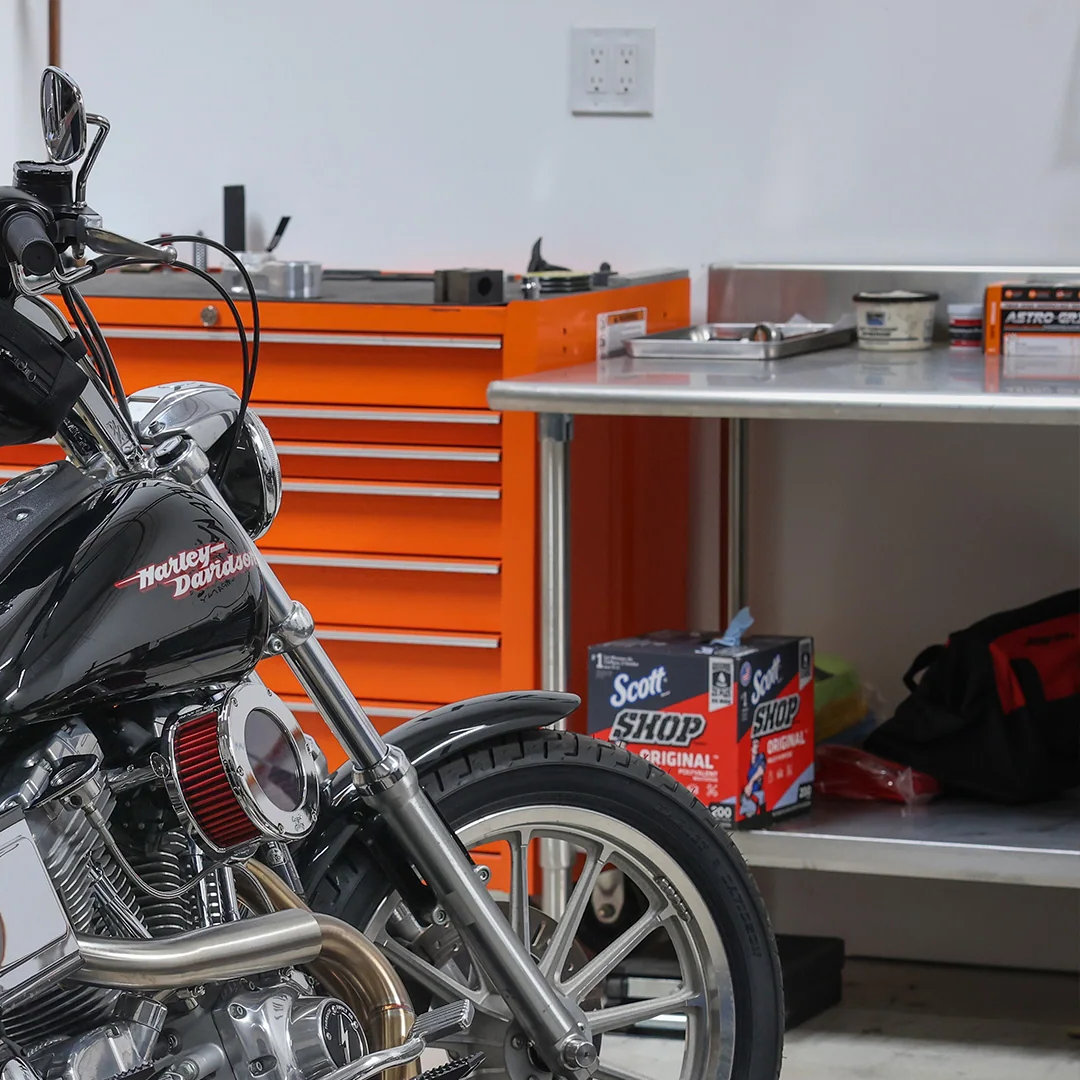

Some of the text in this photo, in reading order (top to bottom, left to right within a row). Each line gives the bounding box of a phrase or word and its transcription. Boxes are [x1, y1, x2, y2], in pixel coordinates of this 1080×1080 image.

[1004, 311, 1080, 324] ASTRO-GR
[610, 666, 667, 708] Scott
[751, 654, 783, 705] Scott
[610, 708, 706, 747] SHOP
[751, 693, 800, 738] SHOP
[639, 748, 714, 769] ORIGINAL
[766, 731, 806, 754] ORIGINAL
